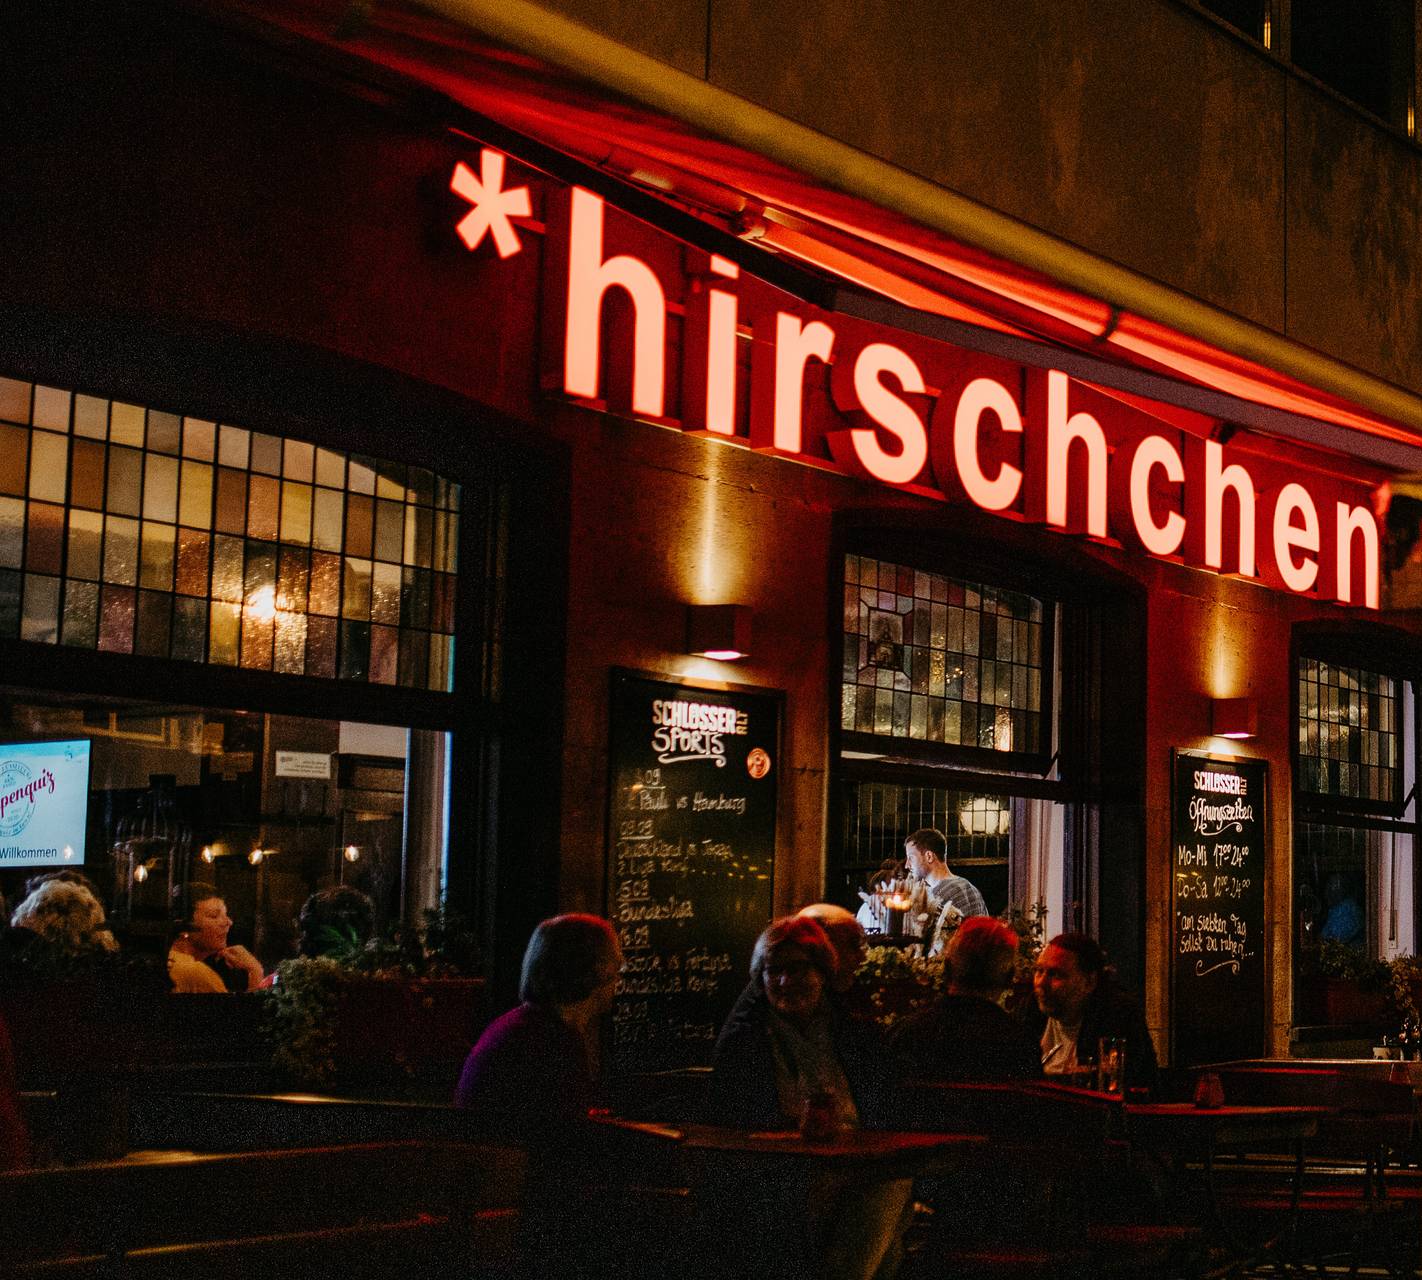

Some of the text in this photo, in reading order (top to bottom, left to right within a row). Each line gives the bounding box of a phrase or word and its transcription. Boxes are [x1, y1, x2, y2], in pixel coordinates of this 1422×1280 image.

[692, 792, 747, 815] Hamburg
[0, 846, 57, 859] Willkommen
[1230, 913, 1247, 943] Tag
